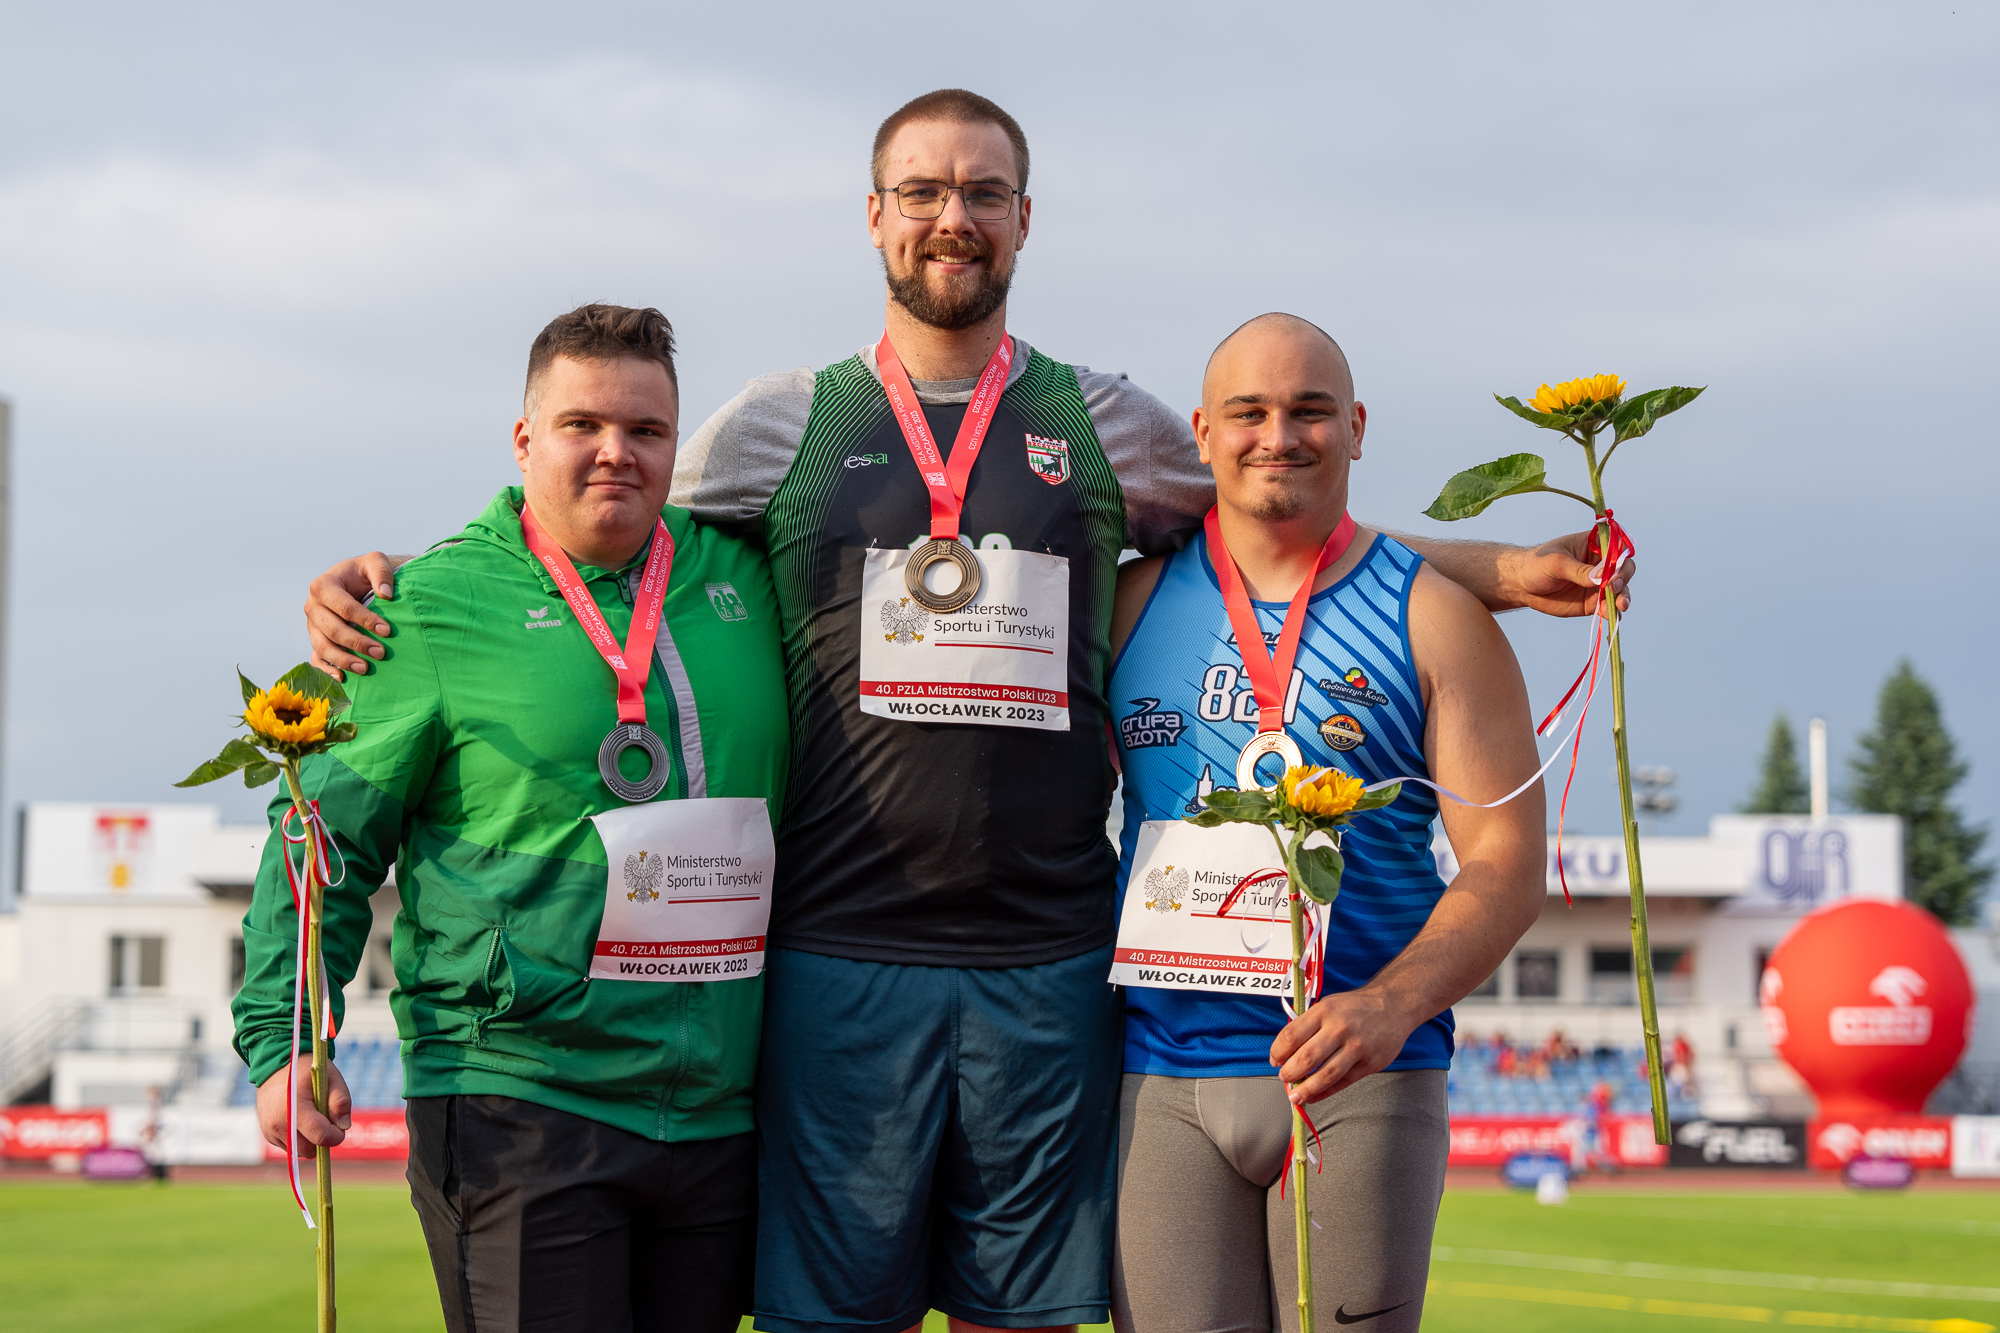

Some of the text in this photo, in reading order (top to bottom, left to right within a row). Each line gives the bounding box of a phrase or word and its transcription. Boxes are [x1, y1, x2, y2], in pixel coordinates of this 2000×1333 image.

[910, 410, 922, 425] 2023
[968, 437, 979, 450] U23
[543, 555, 556, 567] U23
[552, 566, 569, 587] POLSKI
[645, 577, 655, 593] 2023
[575, 586, 588, 602] 2023
[649, 597, 659, 619] POLSKI
[934, 603, 1028, 617] isterstwo
[525, 619, 562, 630] erima
[645, 619, 655, 630] U23
[933, 619, 1055, 640] Sportu i Turystyki
[875, 684, 1057, 704] 40. PZLA Mistrzostwa Polski U23
[888, 702, 1045, 722] WŁOCŁAWEK 2023
[667, 854, 742, 870] Ministerstwo
[666, 871, 763, 890] Sportu i Turystyki
[1194, 870, 1284, 888] Ministestw
[1191, 888, 1314, 910] Sport i Turyski
[610, 939, 757, 956] 40. PZLA Mistrzostwa Polski U23
[619, 958, 748, 975] WŁOCŁAWEK 2023
[1129, 952, 1147, 963] 40.
[1149, 953, 1176, 965] PZLA
[1178, 955, 1248, 970] Mistrzostwa
[1250, 960, 1284, 972] Polski
[1138, 969, 1248, 987] WŁOCŁAWEK
